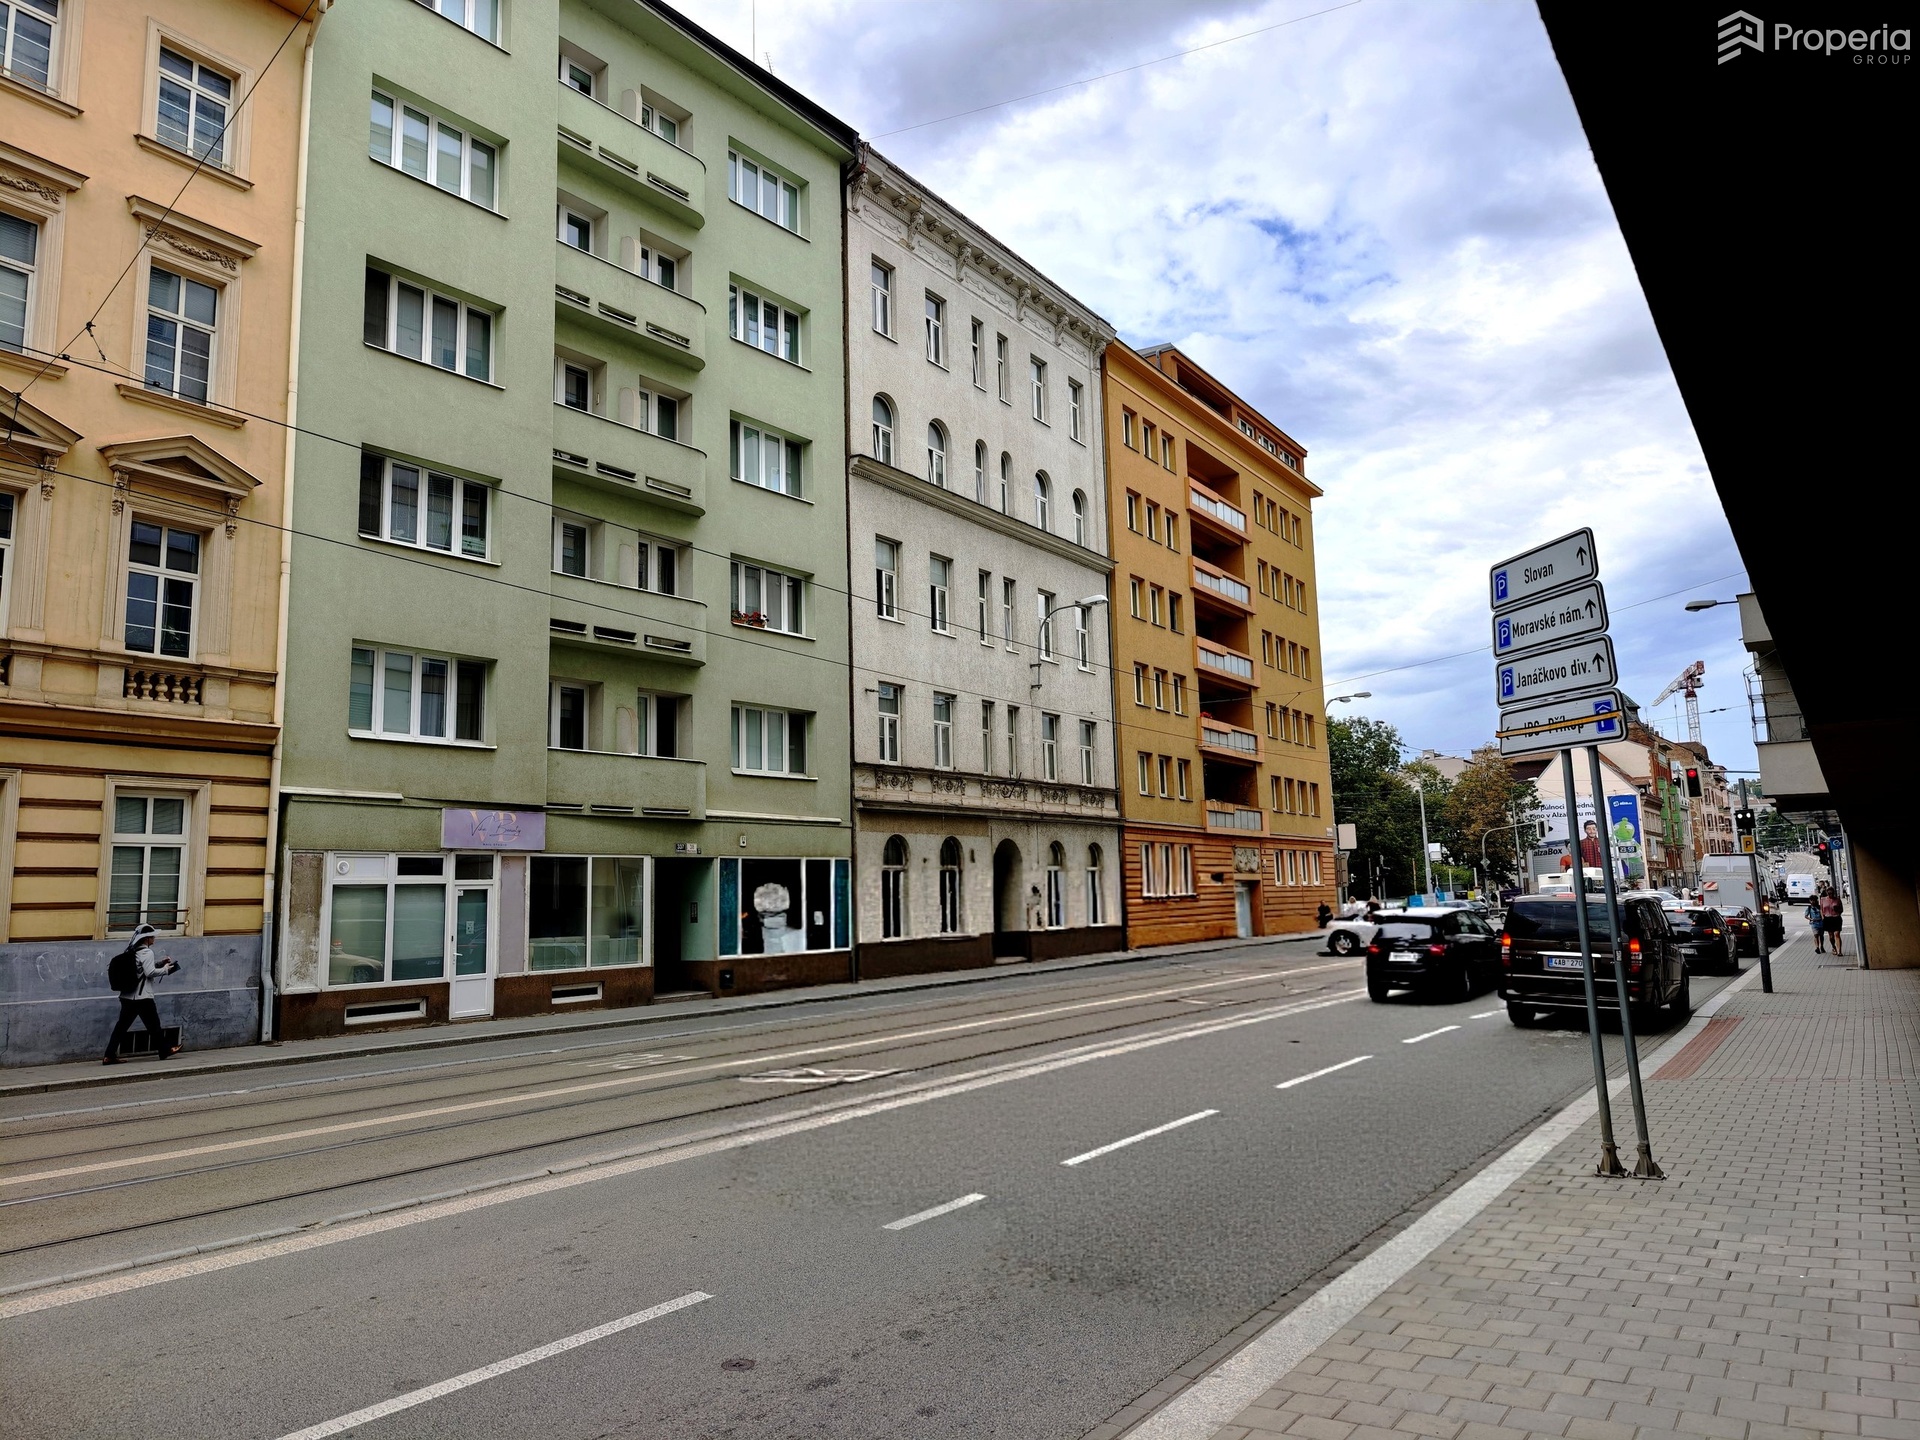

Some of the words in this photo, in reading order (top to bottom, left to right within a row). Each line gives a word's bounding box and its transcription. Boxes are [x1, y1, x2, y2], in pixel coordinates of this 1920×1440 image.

[1524, 563, 1554, 584] Slovan
[1512, 611, 1556, 639] Moravské
[1559, 606, 1585, 625] nám.
[1516, 666, 1567, 689] Janáčkovo
[1571, 659, 1591, 677] div.
[1745, 840, 1752, 848] P
[1533, 847, 1563, 857] alzaBox
[1570, 959, 1583, 967] 270
